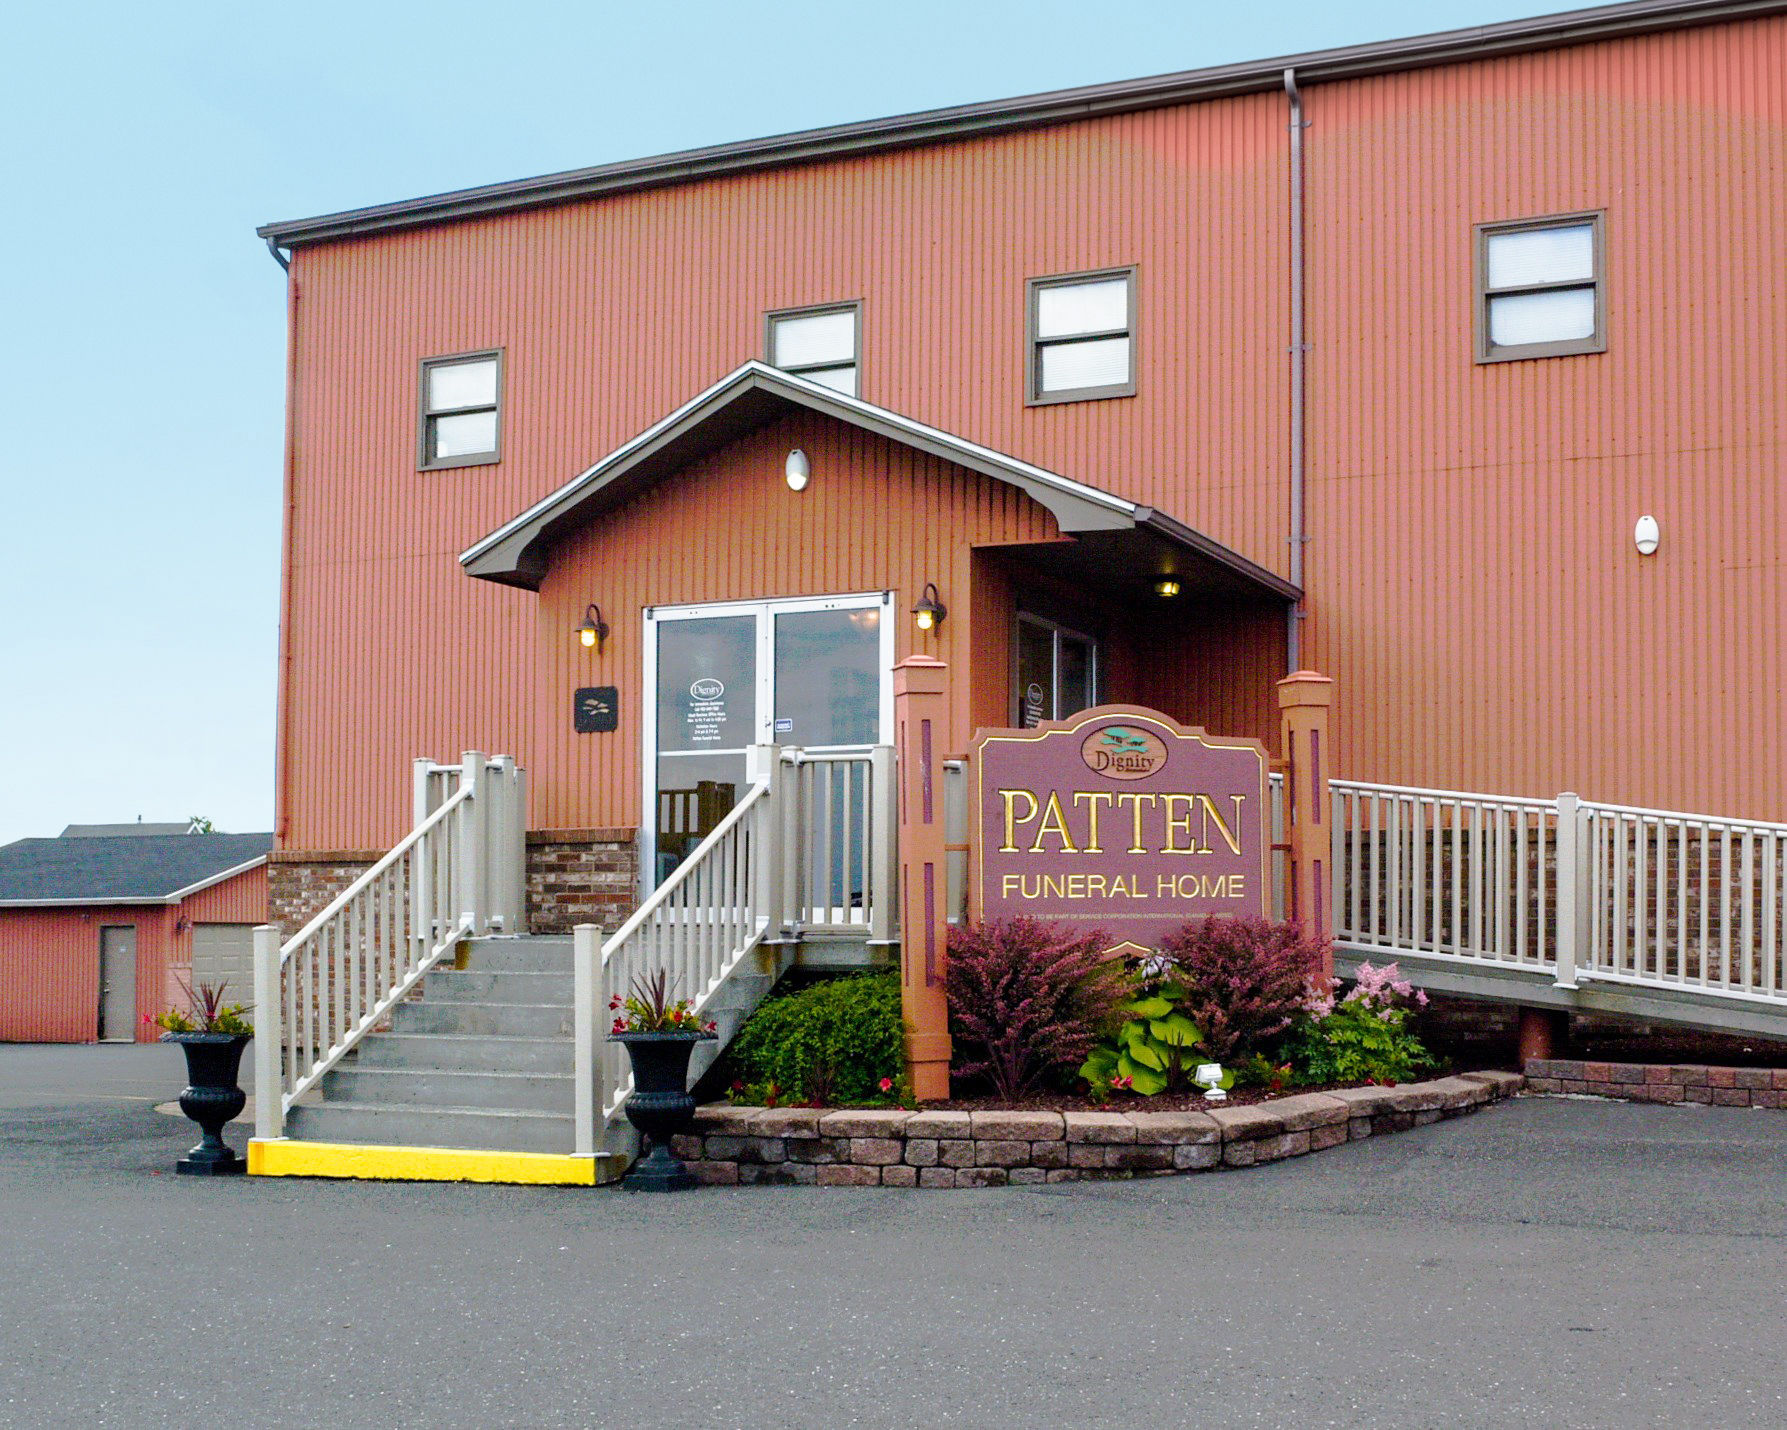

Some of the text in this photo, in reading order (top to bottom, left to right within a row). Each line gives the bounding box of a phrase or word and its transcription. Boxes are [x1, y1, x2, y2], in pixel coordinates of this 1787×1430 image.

[694, 685, 720, 695] Dignity
[1095, 750, 1155, 772] Dignity
[998, 789, 1246, 855] PATTEN
[1002, 874, 1245, 899] FUNERAL HOME
